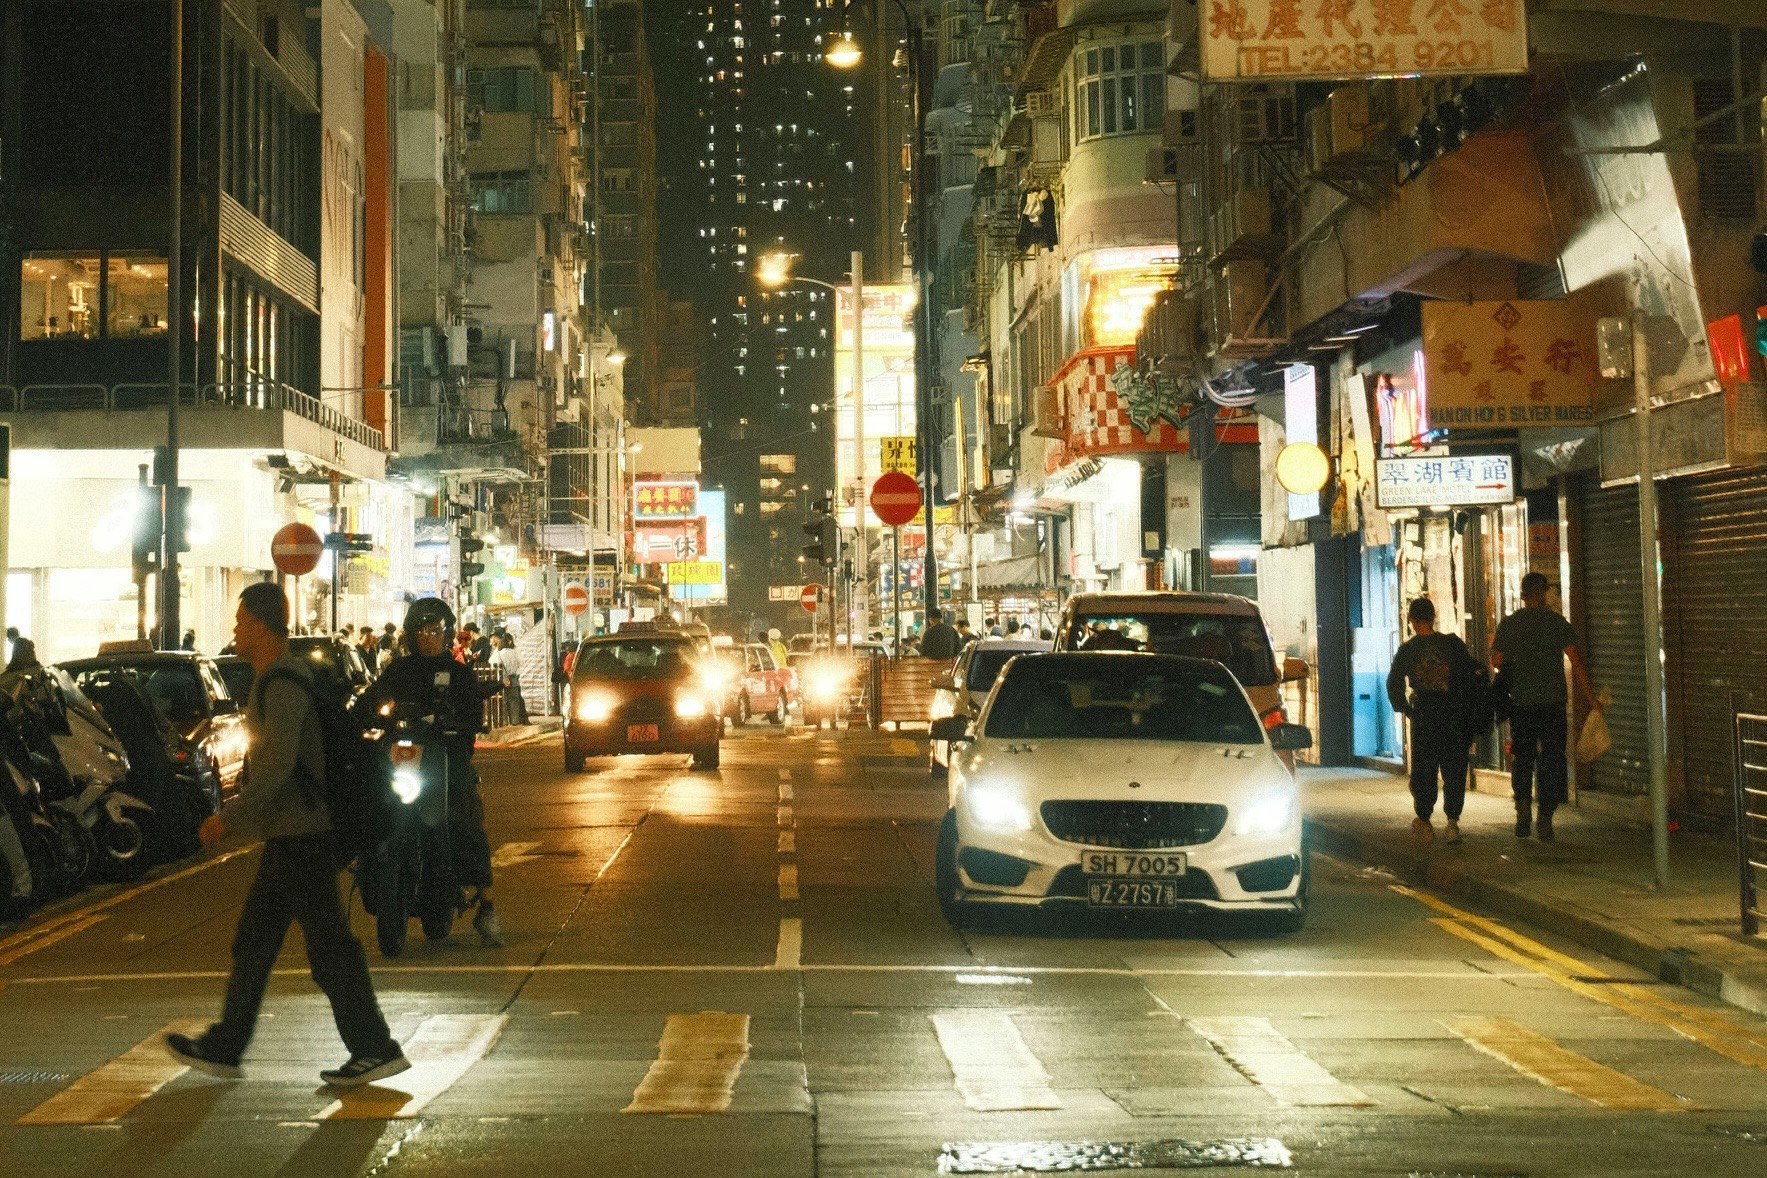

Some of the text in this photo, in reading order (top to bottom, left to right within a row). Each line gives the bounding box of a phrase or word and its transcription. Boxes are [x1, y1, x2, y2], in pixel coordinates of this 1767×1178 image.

[1414, 40, 1493, 68] 9201
[1510, 405, 1551, 422] SILVER
[1381, 458, 1508, 485] 翠湖賓館
[1381, 486, 1411, 497] GREEN
[1415, 485, 1437, 495] LAKE
[1090, 854, 1180, 875] SH 7005
